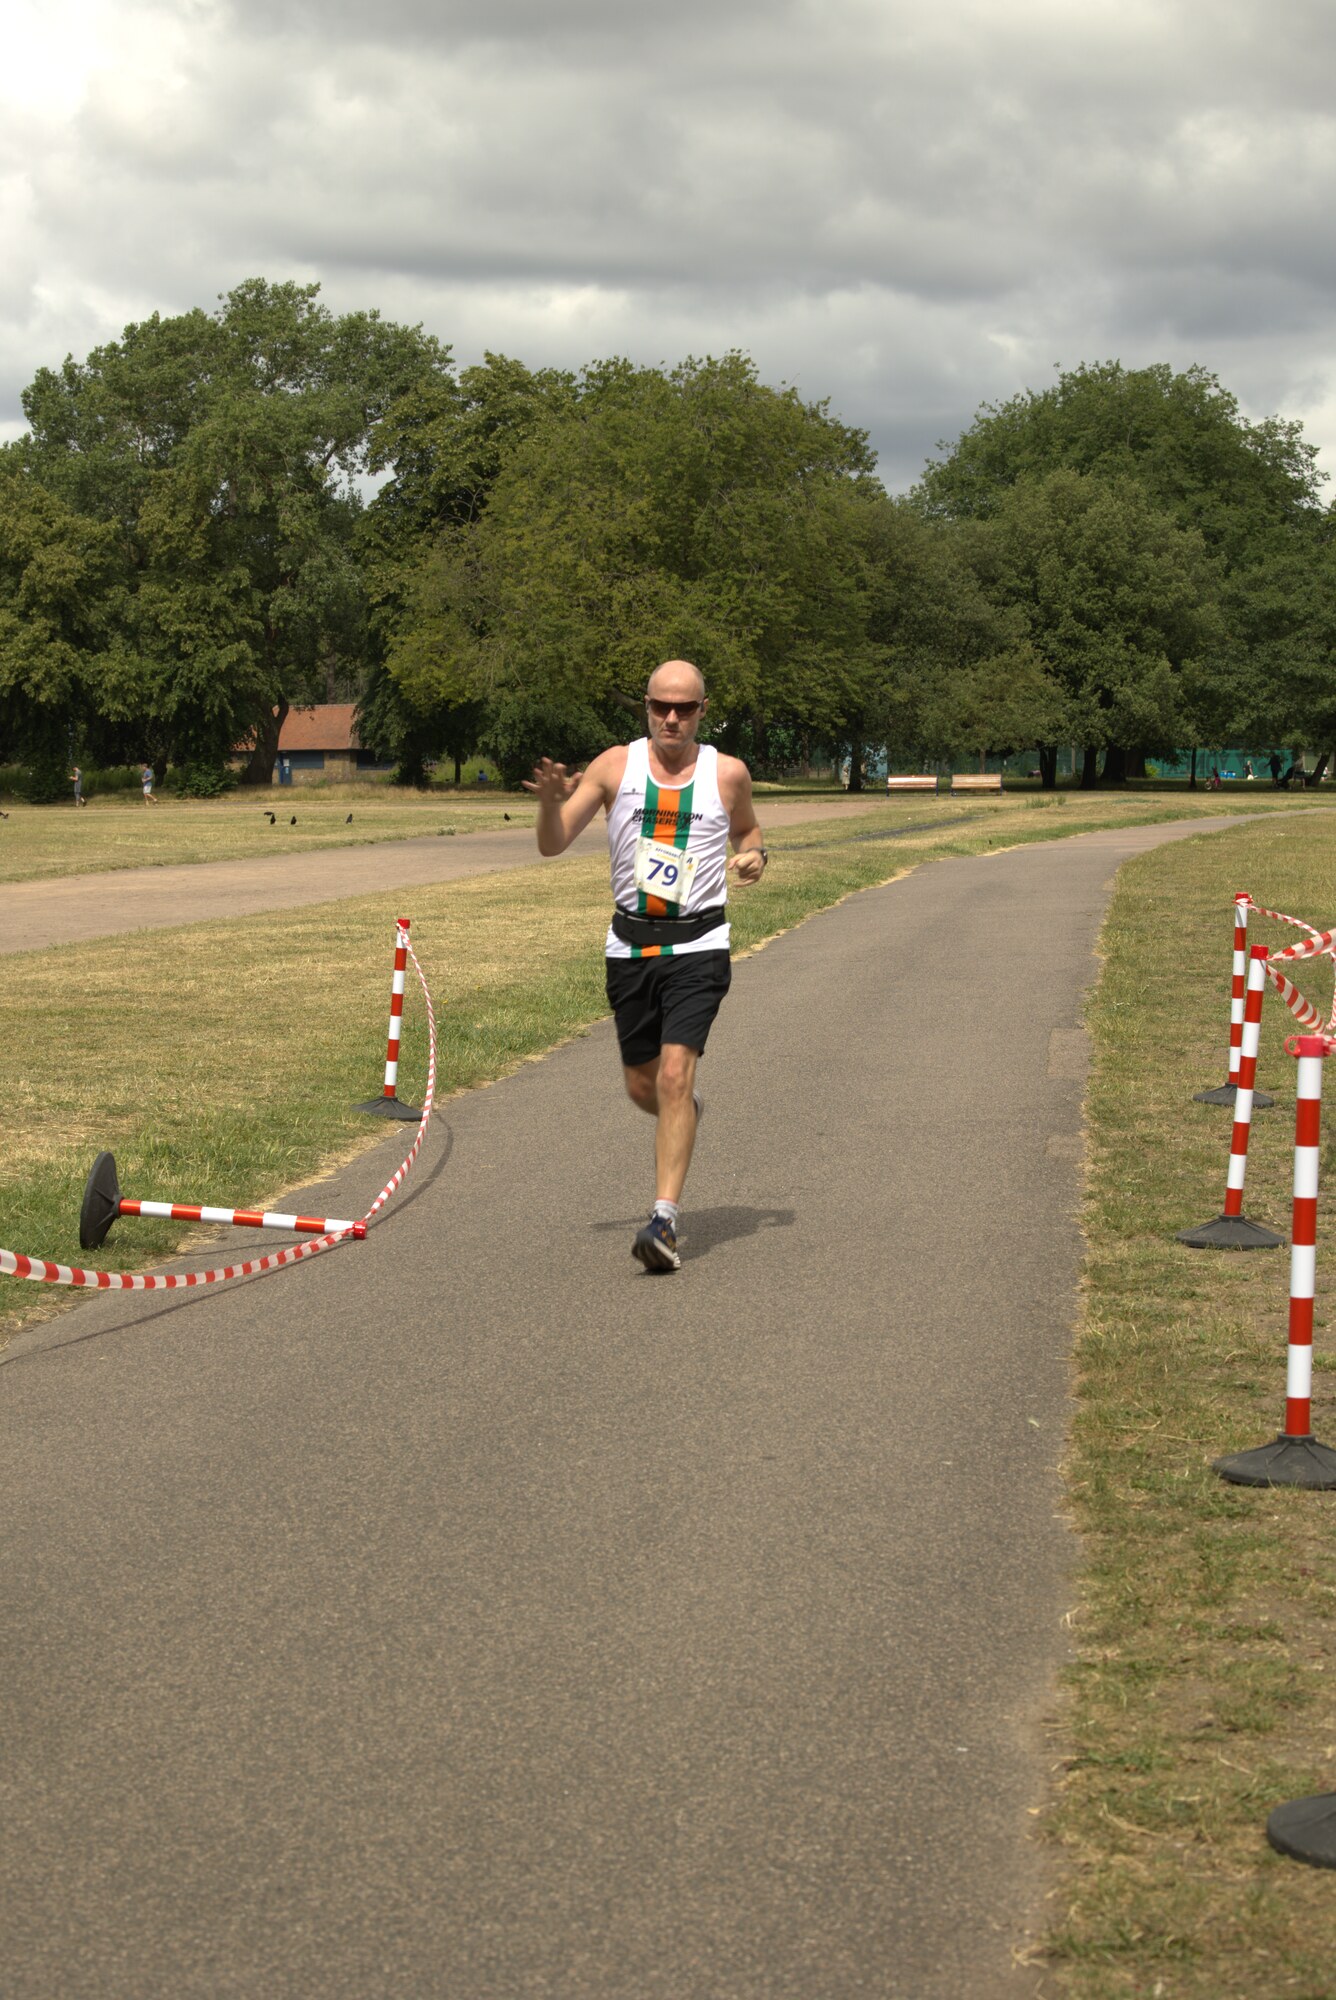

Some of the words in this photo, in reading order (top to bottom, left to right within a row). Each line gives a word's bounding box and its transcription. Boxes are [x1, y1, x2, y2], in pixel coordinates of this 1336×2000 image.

[631, 815, 678, 826] CHASERS
[632, 808, 703, 821] MORNINGTON
[646, 857, 679, 886] 79
